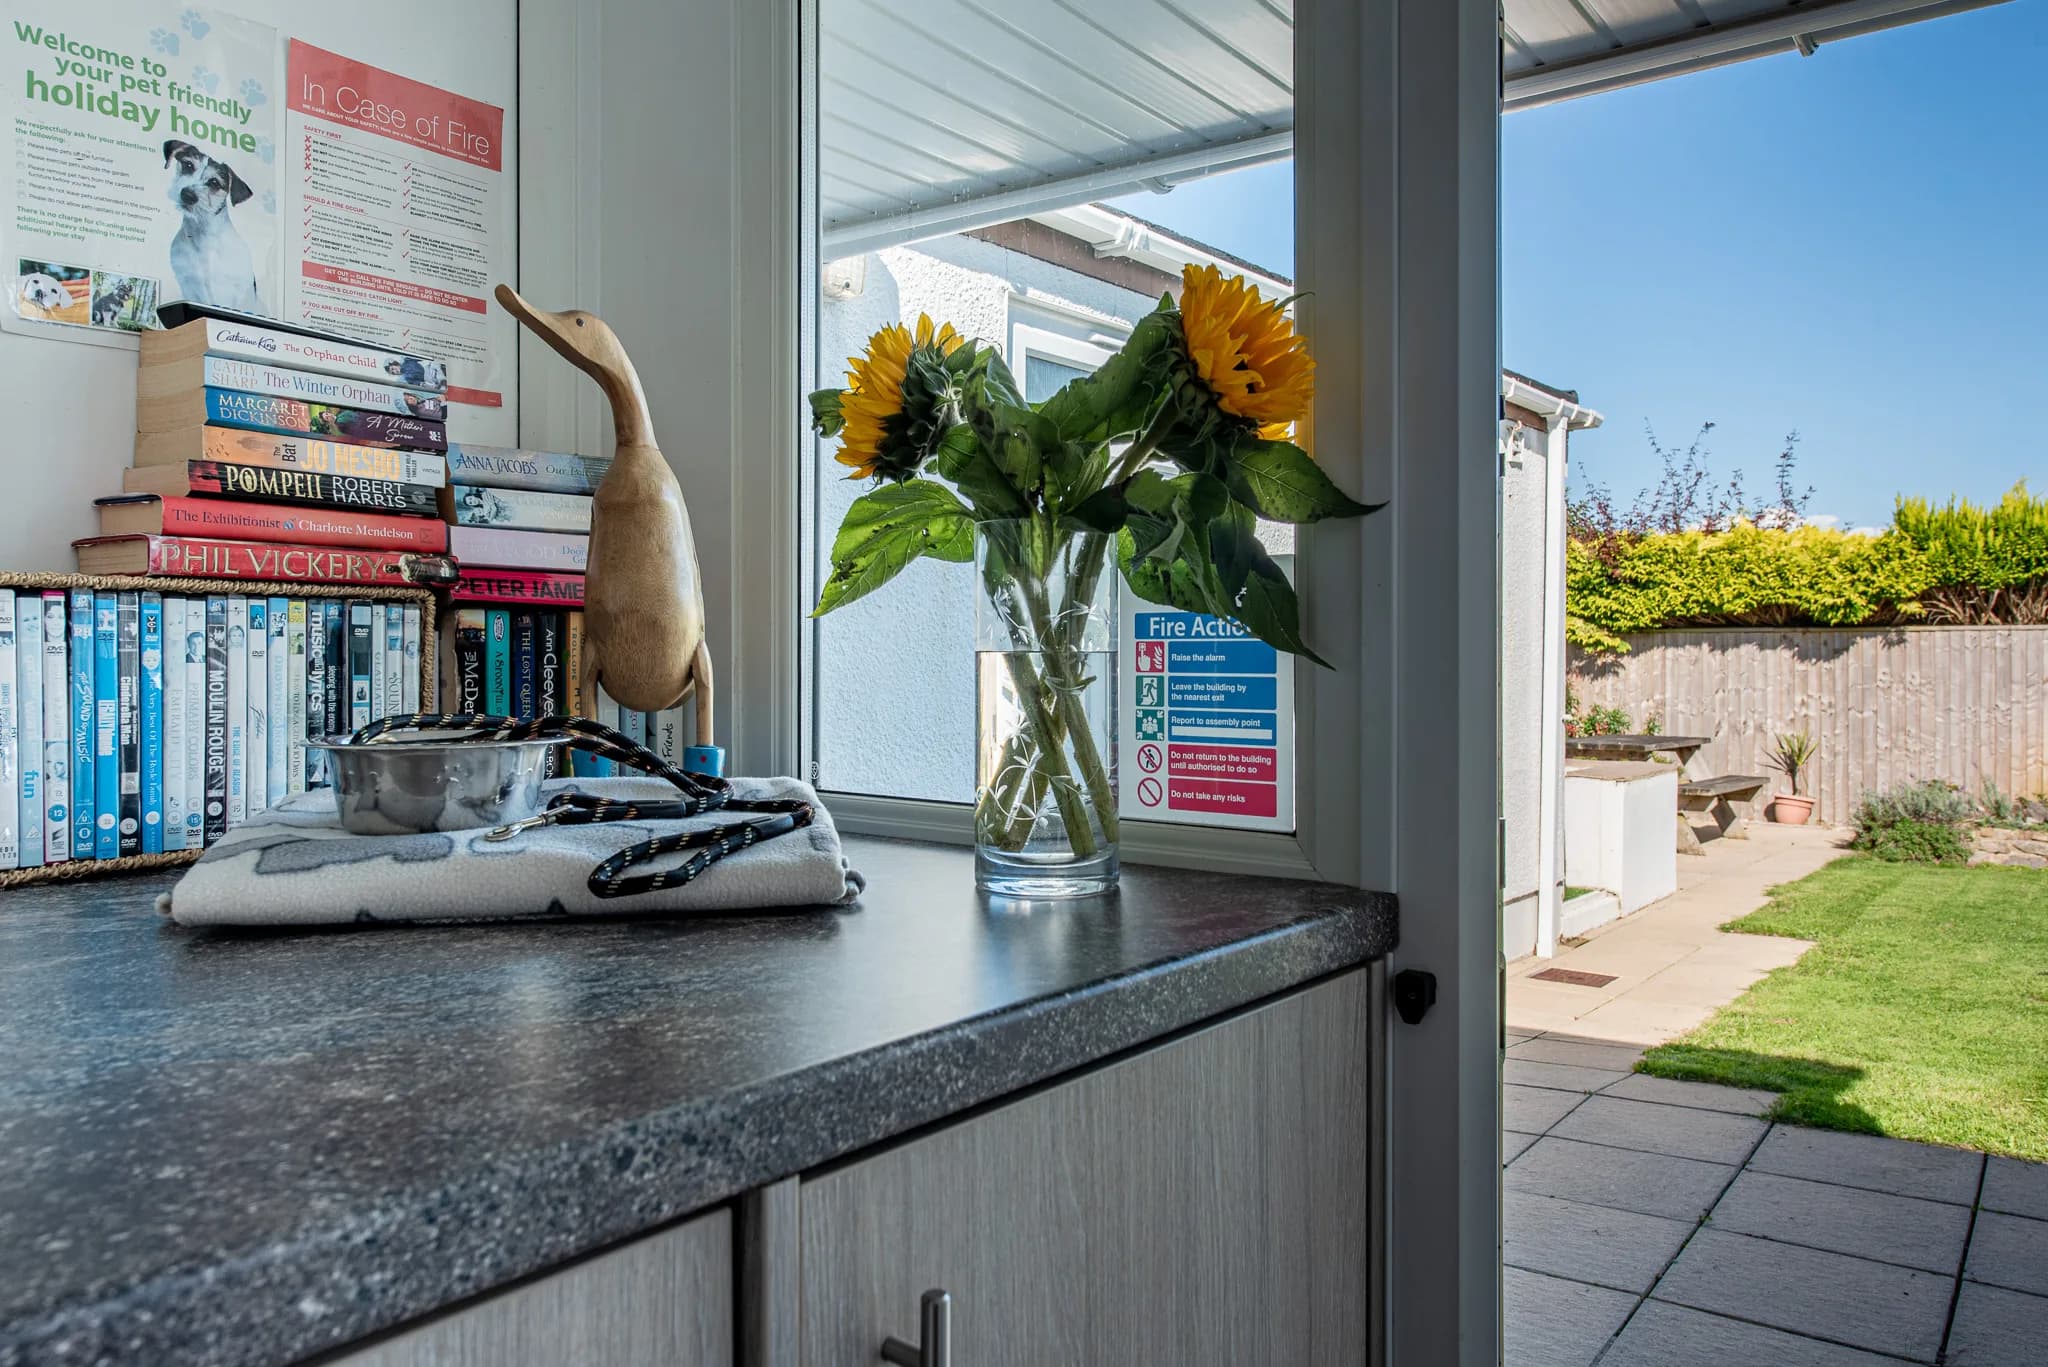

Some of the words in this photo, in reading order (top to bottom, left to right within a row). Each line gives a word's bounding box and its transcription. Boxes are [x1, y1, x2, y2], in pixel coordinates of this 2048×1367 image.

[14, 20, 135, 70] Welcome
[141, 57, 167, 78] to
[55, 56, 113, 83] your
[120, 74, 161, 97] pet
[168, 82, 252, 125] friendly
[26, 69, 160, 132] holiday
[170, 105, 256, 153] home
[303, 73, 325, 106] In
[336, 86, 406, 129] Case
[415, 115, 440, 141] of
[447, 119, 489, 155] Fire
[327, 111, 344, 119] ABOUT
[28, 122, 73, 137] respectfully
[116, 140, 148, 152] attention
[303, 124, 325, 135] SAFETY
[325, 130, 342, 140] FIRST
[303, 193, 326, 205] SHOULD
[16, 205, 38, 215] There
[58, 213, 82, 224] charge
[95, 220, 125, 232] cleaning
[125, 225, 146, 235] unless
[16, 215, 55, 226] additional
[55, 221, 77, 232] heavy
[79, 226, 109, 238] cleaning
[116, 233, 145, 243] required
[16, 223, 52, 236] following
[52, 229, 70, 238] your
[342, 288, 368, 298] CLOTHES
[368, 292, 387, 302] CATCH
[257, 337, 277, 353] King
[283, 343, 300, 353] The
[303, 346, 345, 364] Orphan
[347, 354, 377, 369] Child
[211, 372, 259, 390] SHARP
[211, 360, 257, 378] CATHY
[263, 371, 290, 388] The
[292, 375, 339, 397] Winter
[341, 384, 391, 405] Orphan
[219, 393, 308, 417] MARGARET
[219, 406, 309, 430] DICKINSON
[366, 414, 383, 429] A
[384, 416, 424, 433] Mother's
[273, 446, 281, 457] The
[281, 443, 297, 463] Bat
[300, 440, 329, 473] JO
[421, 467, 441, 475] VINTAGE
[455, 452, 493, 470] ANNA
[490, 456, 538, 475] JACOBS
[545, 464, 567, 475] Our
[225, 464, 324, 499] POMPEII
[332, 475, 405, 496] ROBERT
[332, 489, 407, 508] HARRIS
[173, 508, 199, 522] The
[202, 511, 281, 529] Exhibitionist
[298, 519, 353, 534] Charlotte
[356, 524, 413, 540] Mendelson
[160, 543, 241, 575] PHIL
[244, 547, 384, 582] VICKERY
[455, 577, 525, 598] PETER
[311, 611, 325, 658] music
[1149, 616, 1186, 637] Fire
[1190, 615, 1252, 637] Actio
[47, 645, 66, 656] DVD
[521, 630, 531, 652] THE
[521, 656, 531, 681] LOST
[1171, 653, 1191, 662] Raise
[1192, 653, 1204, 662] the
[1205, 654, 1226, 662] alarm
[326, 665, 337, 689] sleeping
[209, 671, 224, 724] MOULIN
[308, 671, 325, 711] lyrics
[328, 690, 337, 702] with
[1171, 683, 1192, 691] Leave
[1193, 683, 1205, 691] the
[1206, 683, 1236, 694] building
[1237, 685, 1247, 694] by
[1171, 692, 1183, 700] the
[1183, 694, 1210, 702] nearest
[1211, 693, 1225, 702] exit
[75, 682, 93, 722] SOUND
[120, 677, 132, 724] Cinderella
[147, 692, 157, 709] Very
[188, 682, 200, 733] PRIMARY
[521, 684, 531, 718] QUEEN
[149, 712, 157, 727] Best
[326, 713, 336, 732] enemy
[1171, 716, 1196, 726] Report
[1196, 717, 1204, 725] to
[1205, 718, 1240, 729] assembly
[1241, 718, 1261, 729] point
[120, 724, 132, 745] Man
[232, 727, 240, 738] THE
[661, 721, 674, 758] Friends
[75, 728, 92, 763] MUSIC
[149, 744, 157, 758] The
[208, 727, 224, 774] ROUGE
[232, 741, 240, 757] EDGE
[188, 736, 201, 780] COLORS
[1170, 751, 1181, 759] Do
[1182, 751, 1195, 760] not
[1195, 753, 1218, 761] return
[1219, 753, 1227, 761] to
[1228, 754, 1240, 762] the
[1241, 755, 1272, 766] building
[1170, 761, 1187, 770] until
[1187, 762, 1226, 773] authorised
[1227, 764, 1236, 772] to
[1236, 765, 1247, 773] do
[1247, 766, 1258, 774] so
[23, 769, 40, 799] fun
[232, 769, 240, 796] REASON
[1171, 790, 1181, 798] Do
[1182, 791, 1195, 799] not
[1195, 791, 1211, 801] take
[1212, 793, 1226, 803] any
[1227, 793, 1246, 803] risks
